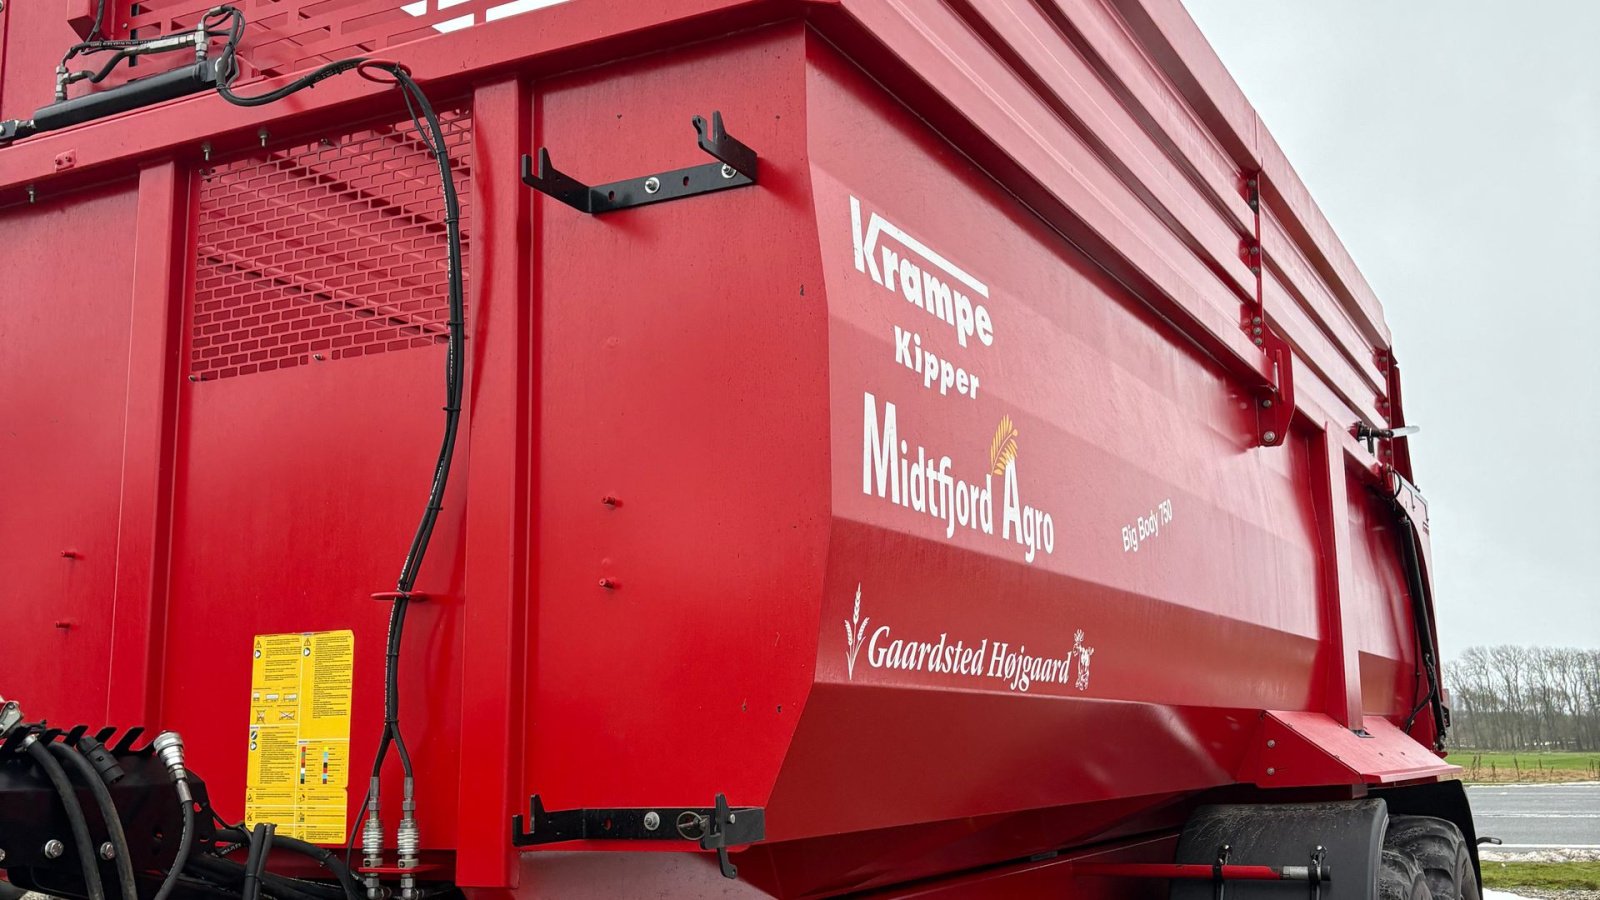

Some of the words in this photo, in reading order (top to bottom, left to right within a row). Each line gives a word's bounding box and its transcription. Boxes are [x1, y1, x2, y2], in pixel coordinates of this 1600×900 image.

[850, 195, 993, 348] Krampe
[894, 325, 980, 400] Kipper
[863, 391, 994, 539] Midtfjord
[1002, 455, 1054, 563] Agro
[1122, 524, 1138, 552] Big
[1137, 509, 1158, 541] Body
[1158, 498, 1172, 526] 750
[868, 625, 988, 676] Gaardsted
[987, 641, 1073, 692] Højgaard
